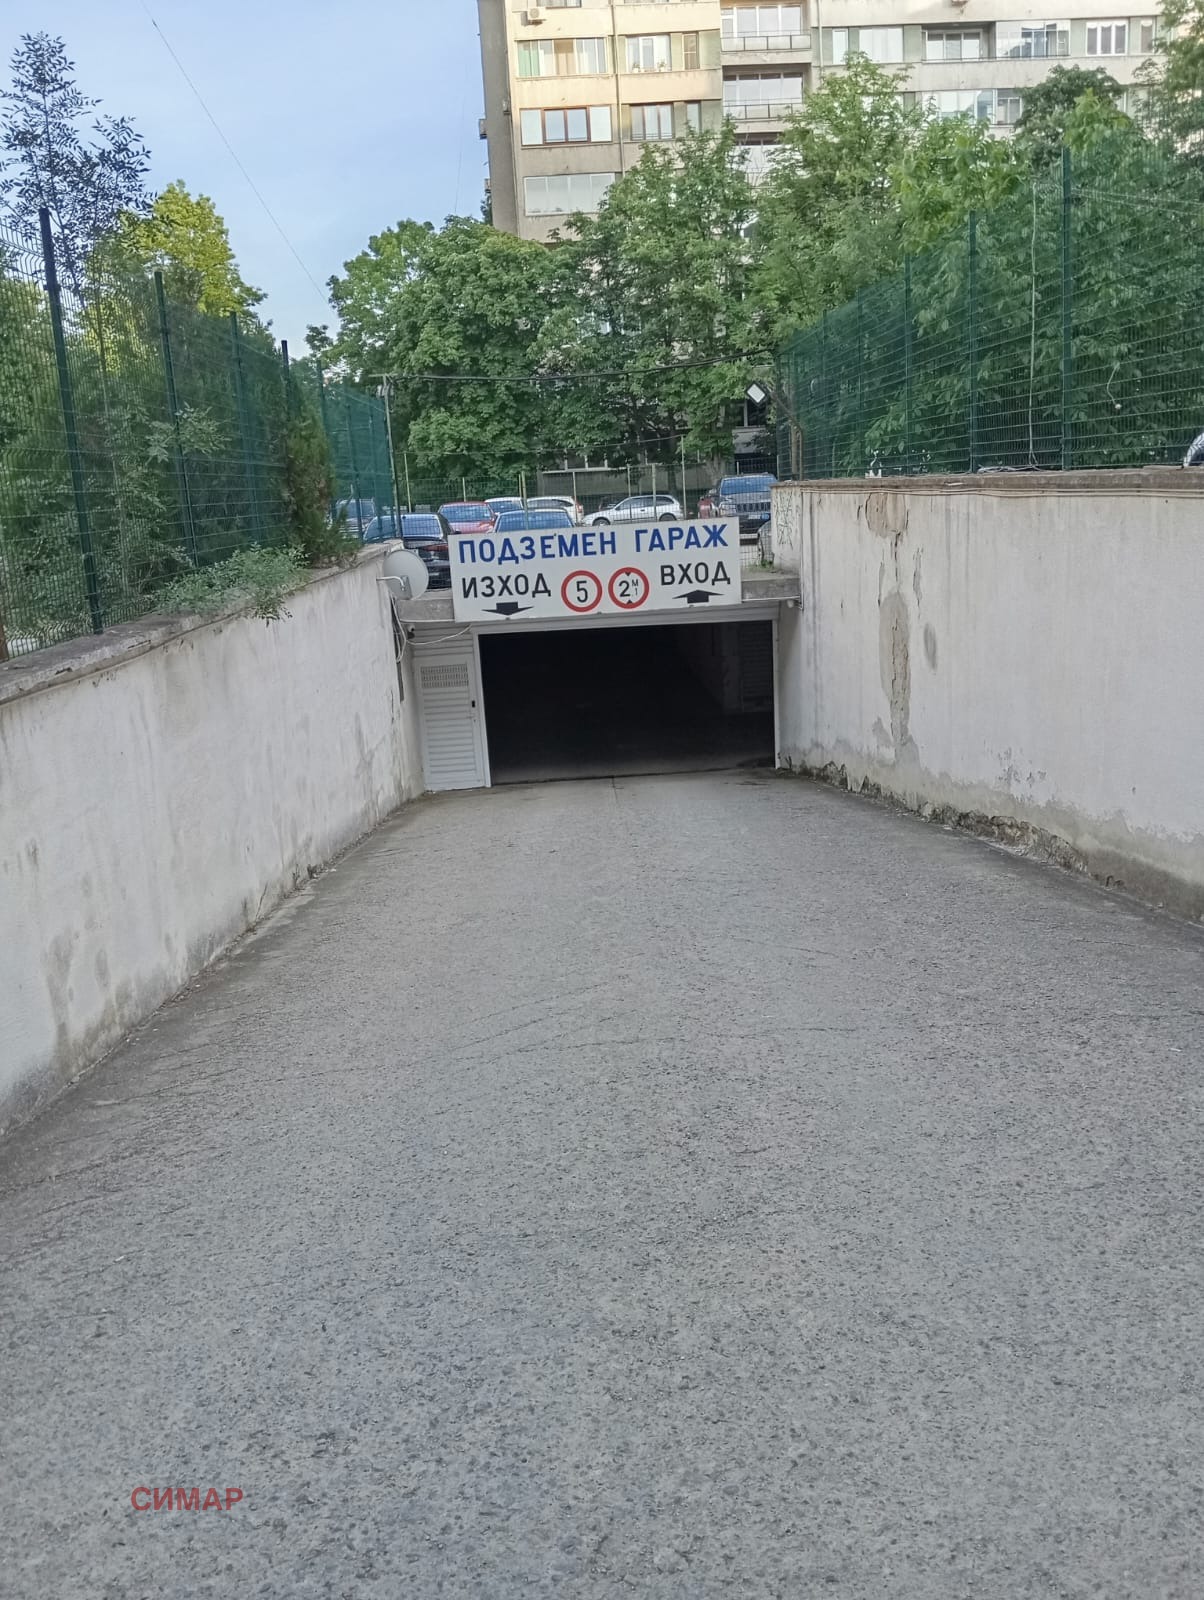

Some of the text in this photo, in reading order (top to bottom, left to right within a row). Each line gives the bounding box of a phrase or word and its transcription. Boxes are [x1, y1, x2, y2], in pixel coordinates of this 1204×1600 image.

[458, 523, 729, 565] ПОДЗЕМЕН ГАРАЖ
[461, 572, 552, 599] ИЗХОД
[660, 561, 731, 586] ВХОД
[576, 580, 588, 603] 5
